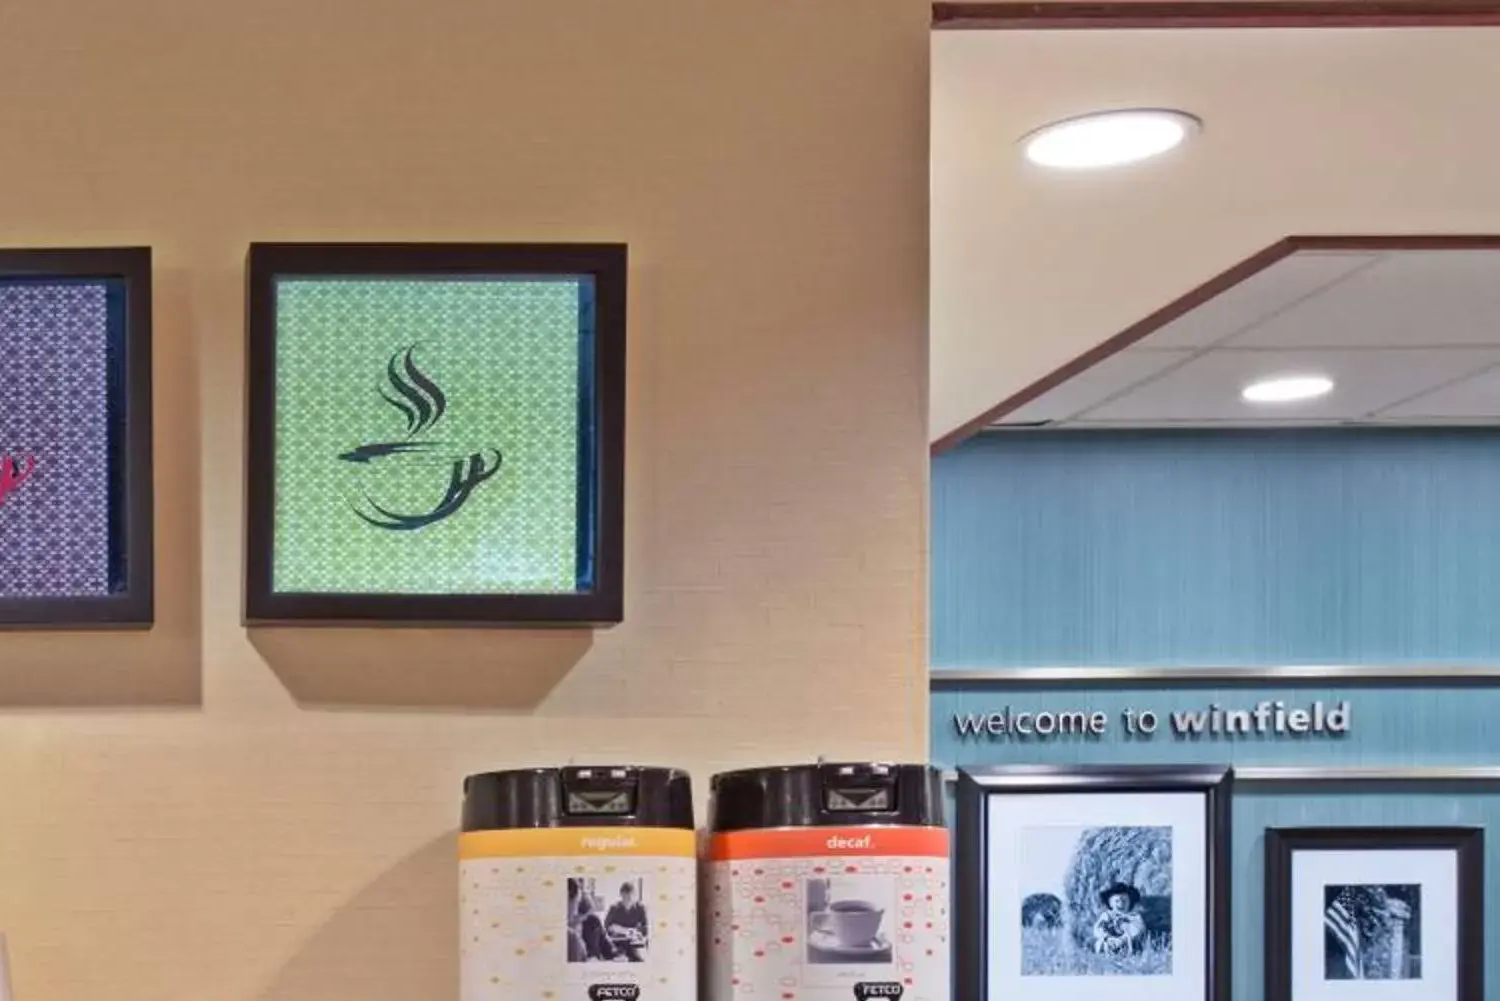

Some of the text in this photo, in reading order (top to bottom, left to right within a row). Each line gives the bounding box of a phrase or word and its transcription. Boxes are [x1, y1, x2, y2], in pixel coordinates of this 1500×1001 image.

[954, 701, 1352, 736] welcome to winfield
